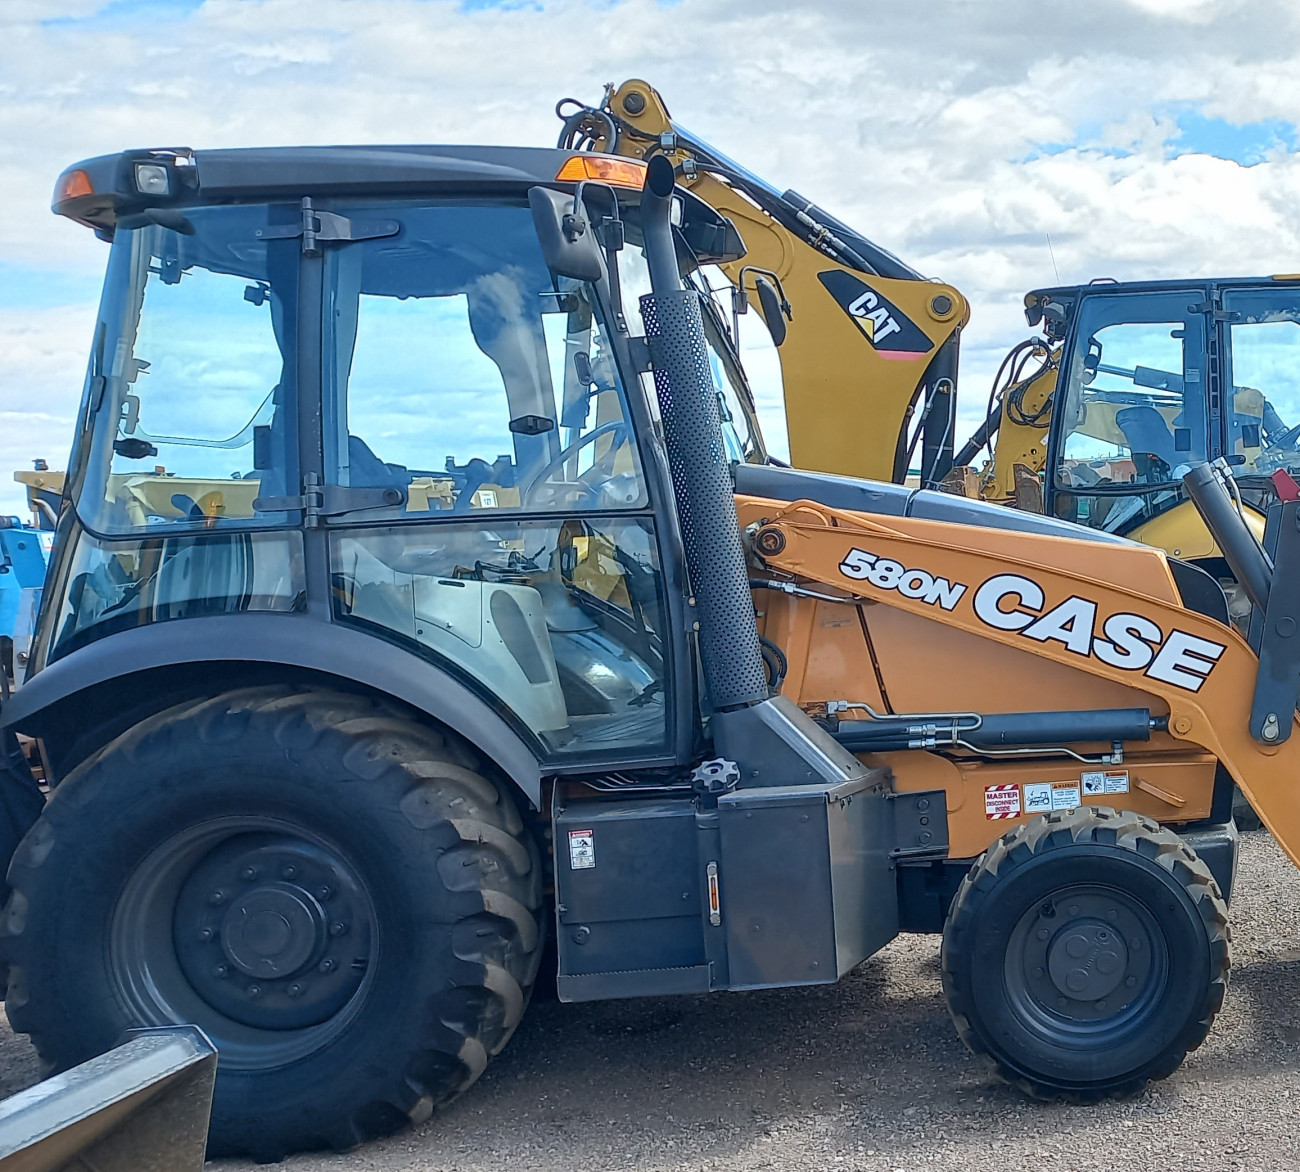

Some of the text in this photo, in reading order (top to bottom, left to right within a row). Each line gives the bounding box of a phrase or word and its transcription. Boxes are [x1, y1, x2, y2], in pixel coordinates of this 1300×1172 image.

[847, 290, 902, 345] CAT
[838, 547, 1228, 693] 580N CASE
[986, 792, 1018, 800] MASTER
[986, 799, 1018, 807] DISCONNECT
